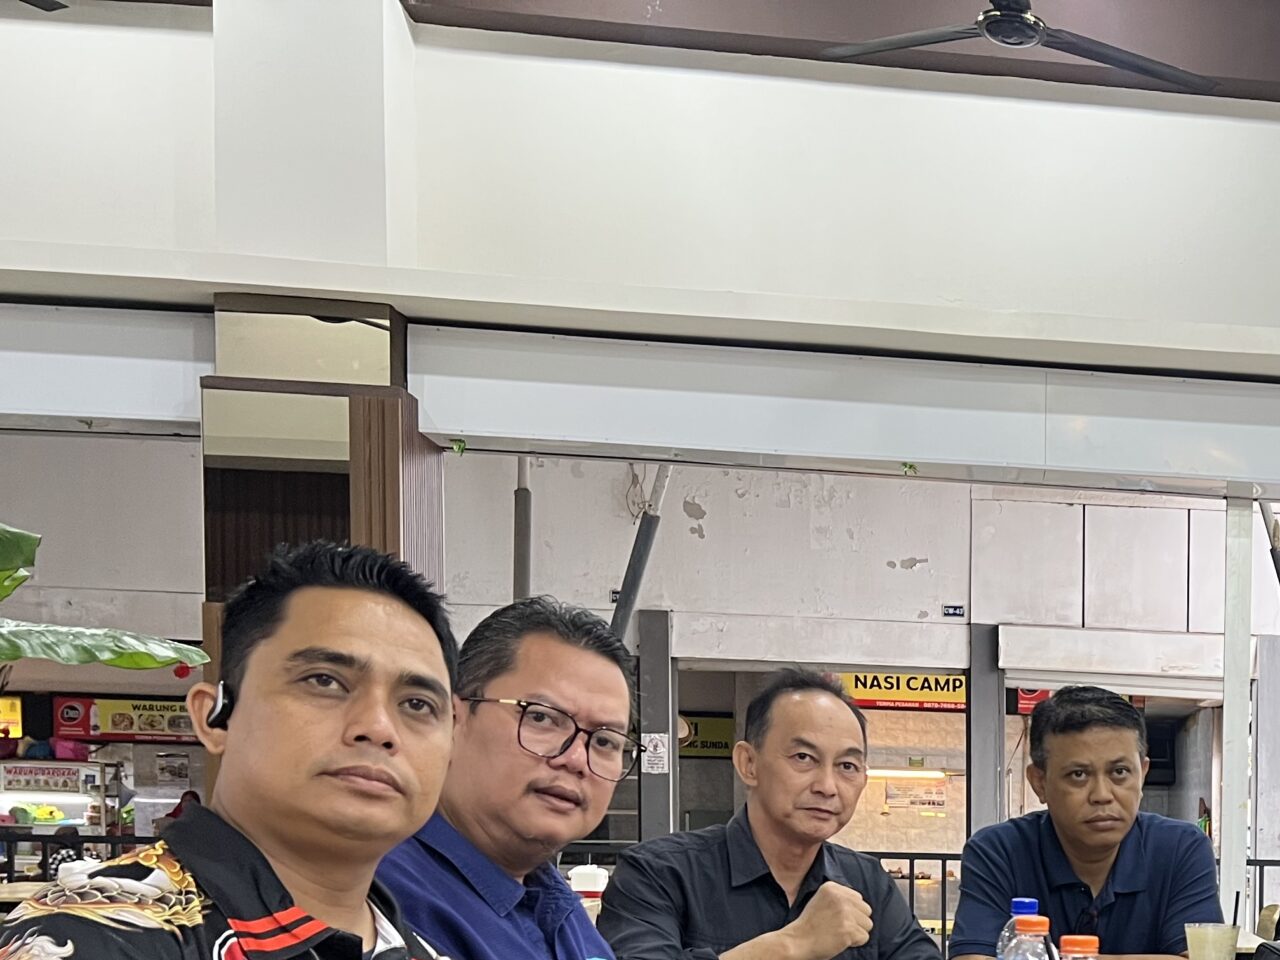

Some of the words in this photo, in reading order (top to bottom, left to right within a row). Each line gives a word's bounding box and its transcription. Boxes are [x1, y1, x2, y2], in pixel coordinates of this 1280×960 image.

[854, 674, 900, 690] NASI
[906, 676, 963, 692] CAMP
[131, 703, 177, 712] WARUNG
[700, 740, 729, 749] SUNDA
